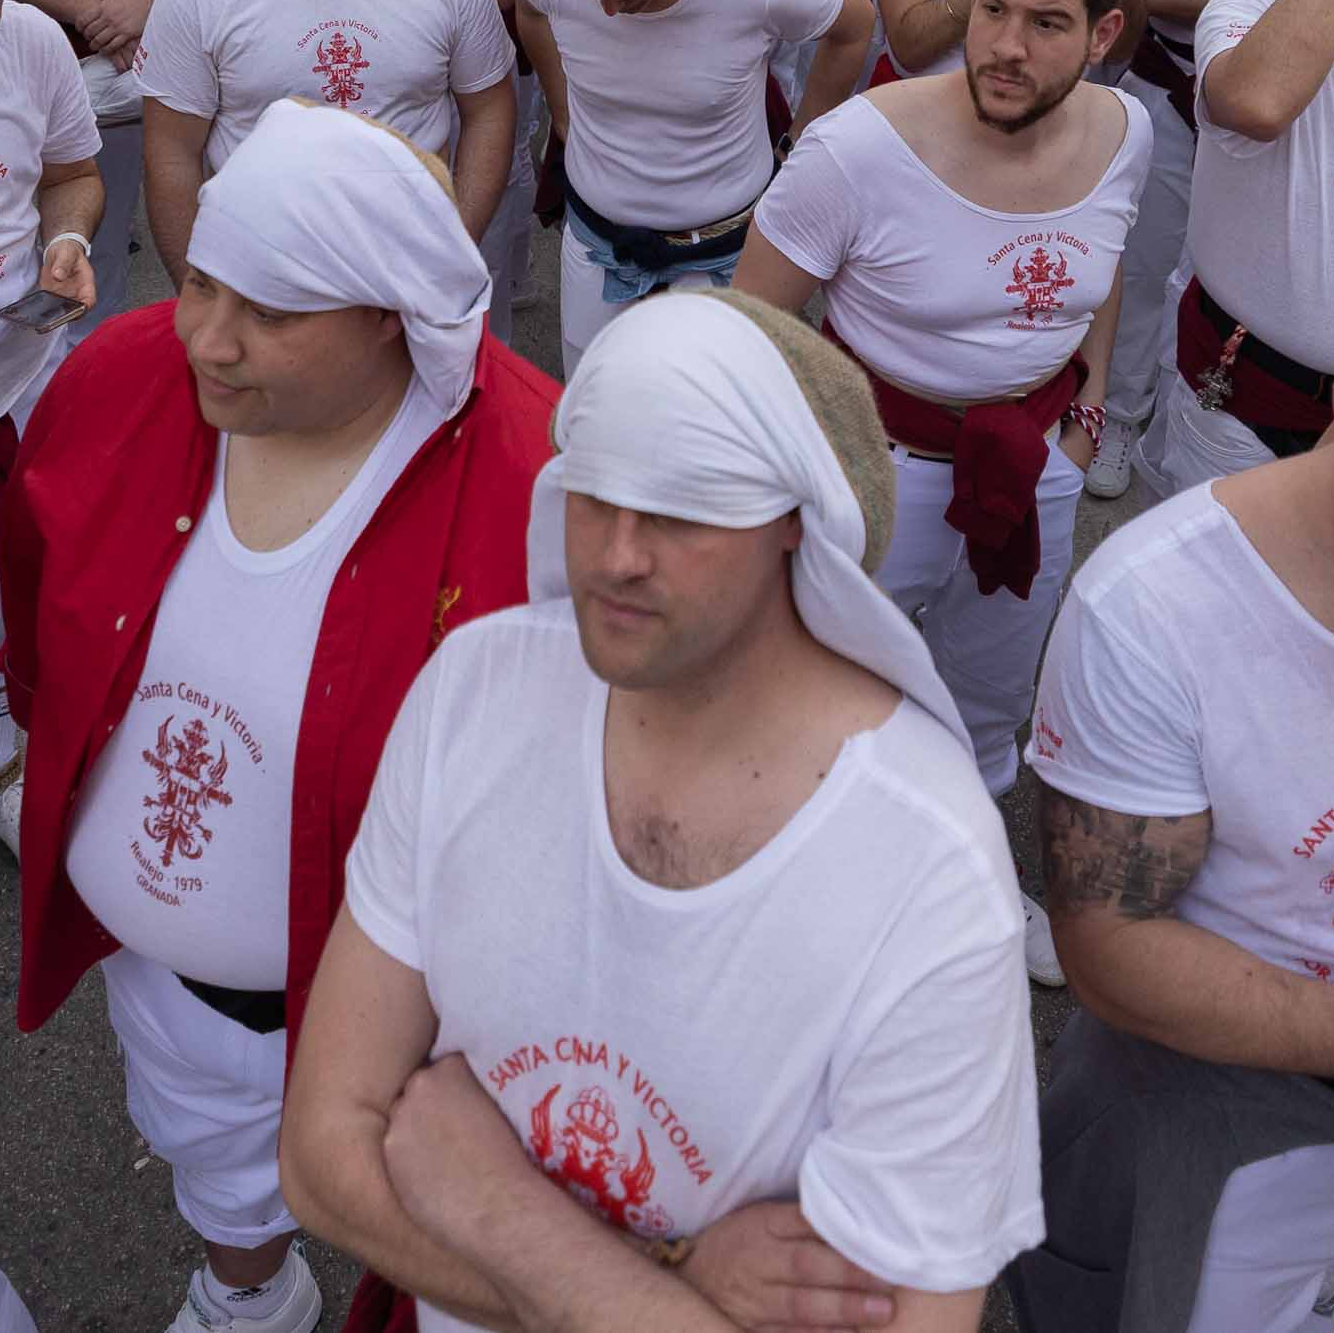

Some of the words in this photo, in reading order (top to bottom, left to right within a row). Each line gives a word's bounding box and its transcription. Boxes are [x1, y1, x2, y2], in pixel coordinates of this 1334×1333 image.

[297, 27, 320, 49] Santa
[318, 20, 341, 32] Cena
[348, 18, 379, 40] Victoria
[987, 241, 1016, 266] Santa
[1016, 232, 1043, 246] Cena
[1046, 232, 1053, 243] y
[1055, 230, 1090, 256] Victoria
[176, 681, 210, 710] Cena
[210, 701, 222, 719] y
[223, 704, 265, 765] Victoria
[129, 840, 165, 883] Realejo
[174, 876, 204, 892] 1979
[137, 874, 181, 907] GRANADA
[487, 1044, 550, 1092] SANTA
[618, 1052, 631, 1081] Y
[633, 1068, 714, 1187] VICTORIA
